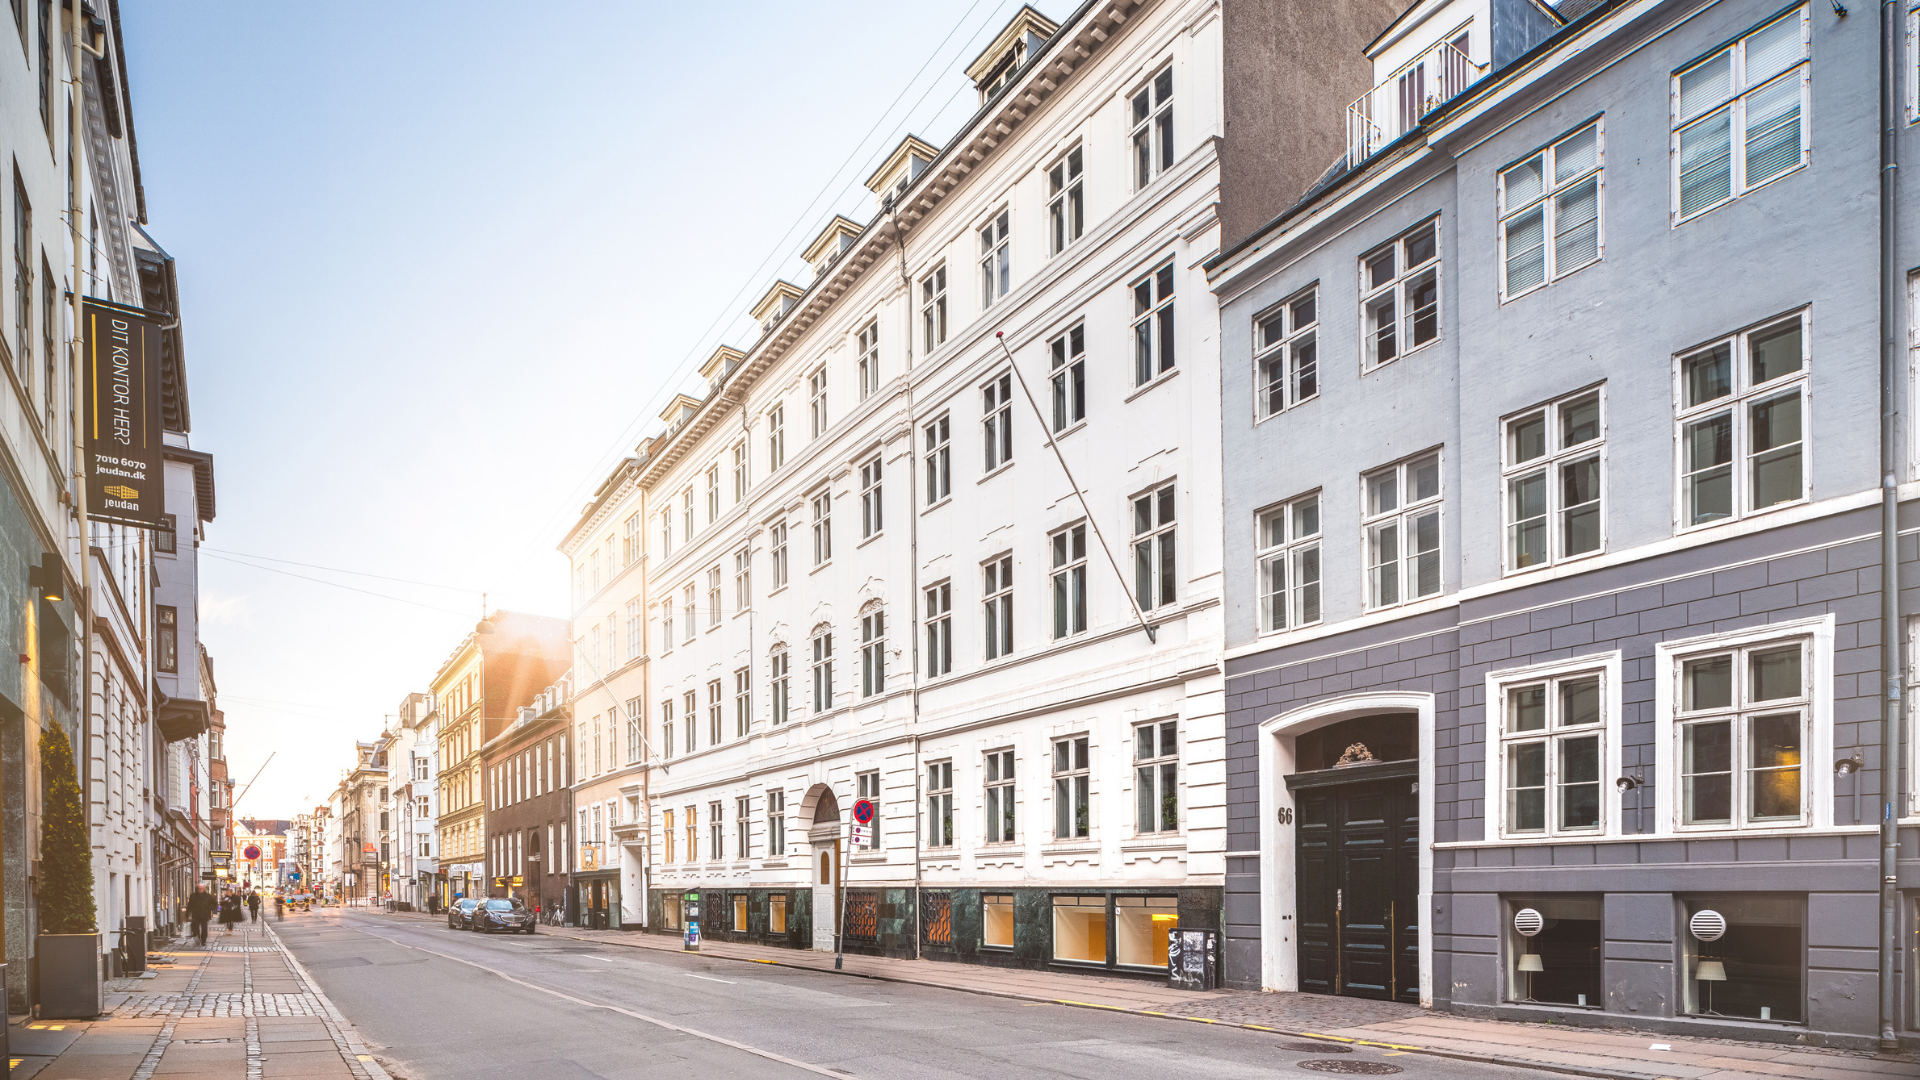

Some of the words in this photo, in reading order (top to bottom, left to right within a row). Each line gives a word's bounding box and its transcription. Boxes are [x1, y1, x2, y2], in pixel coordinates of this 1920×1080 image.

[112, 319, 128, 345] DIT
[112, 346, 129, 405] KONTOR
[113, 408, 130, 445] HER?
[95, 454, 119, 465] 7010
[120, 458, 146, 470] 6070
[95, 464, 146, 480] jeudan.dk
[104, 498, 139, 511] jeudan
[1277, 807, 1293, 825] 66
